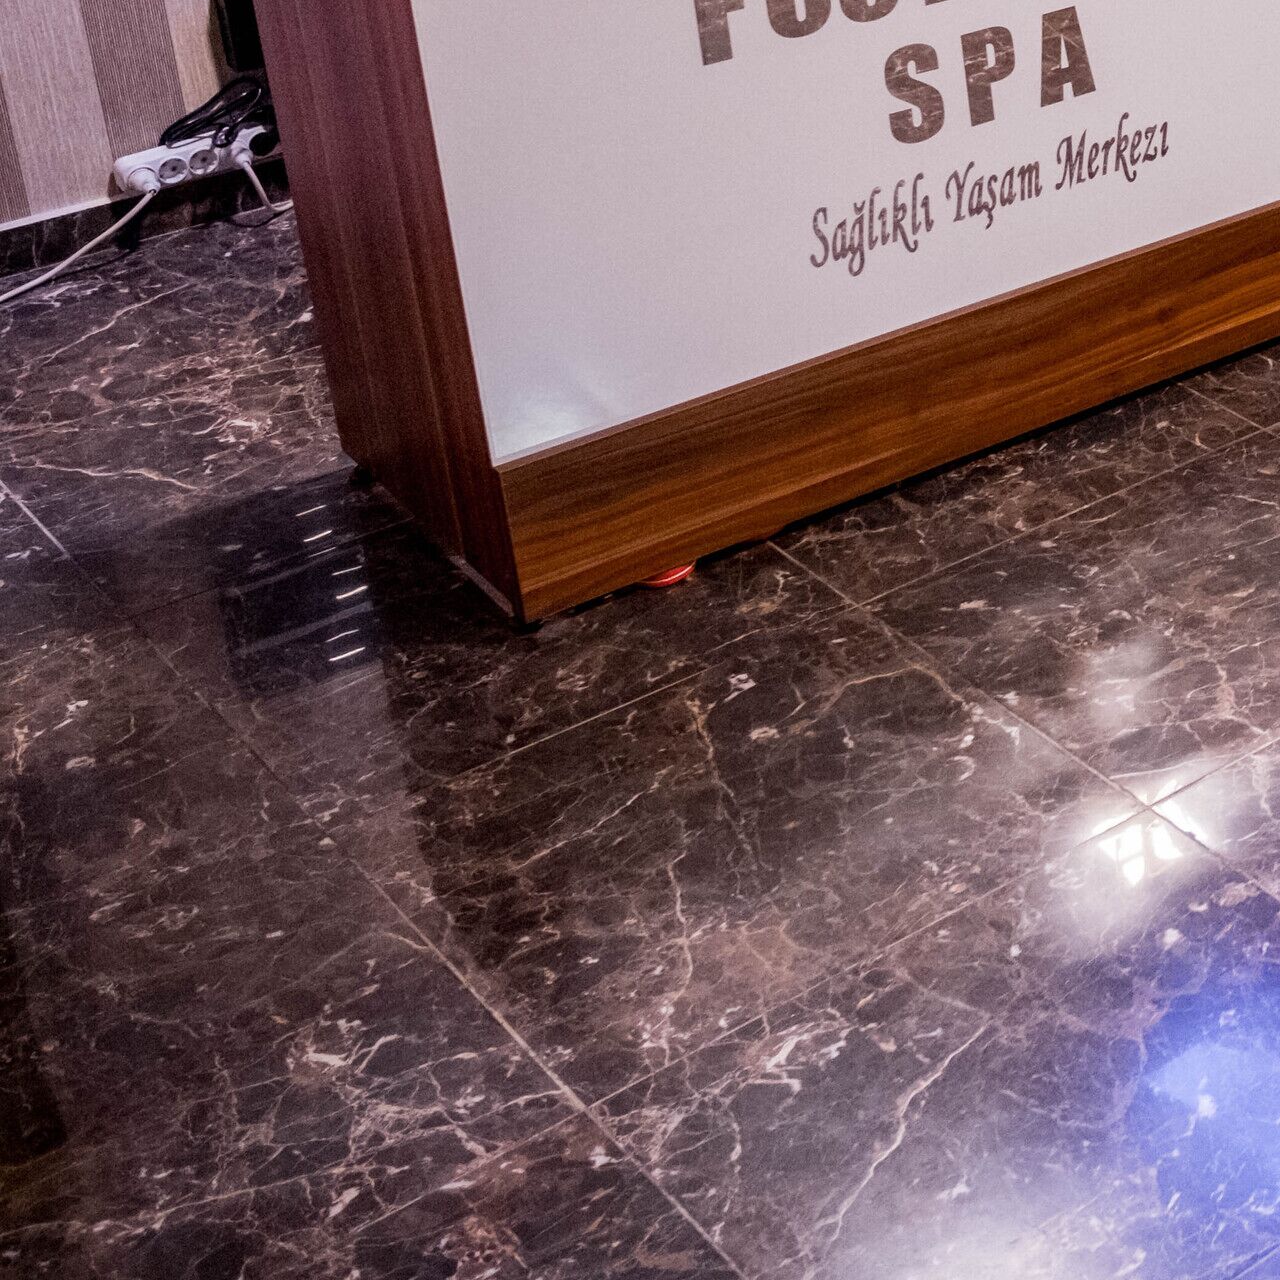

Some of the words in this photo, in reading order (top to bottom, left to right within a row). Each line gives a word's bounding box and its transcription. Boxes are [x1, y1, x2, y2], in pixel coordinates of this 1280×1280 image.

[883, 6, 1097, 145] SPA
[810, 172, 935, 277] Sağlıklı
[945, 161, 1043, 230] Yaşam
